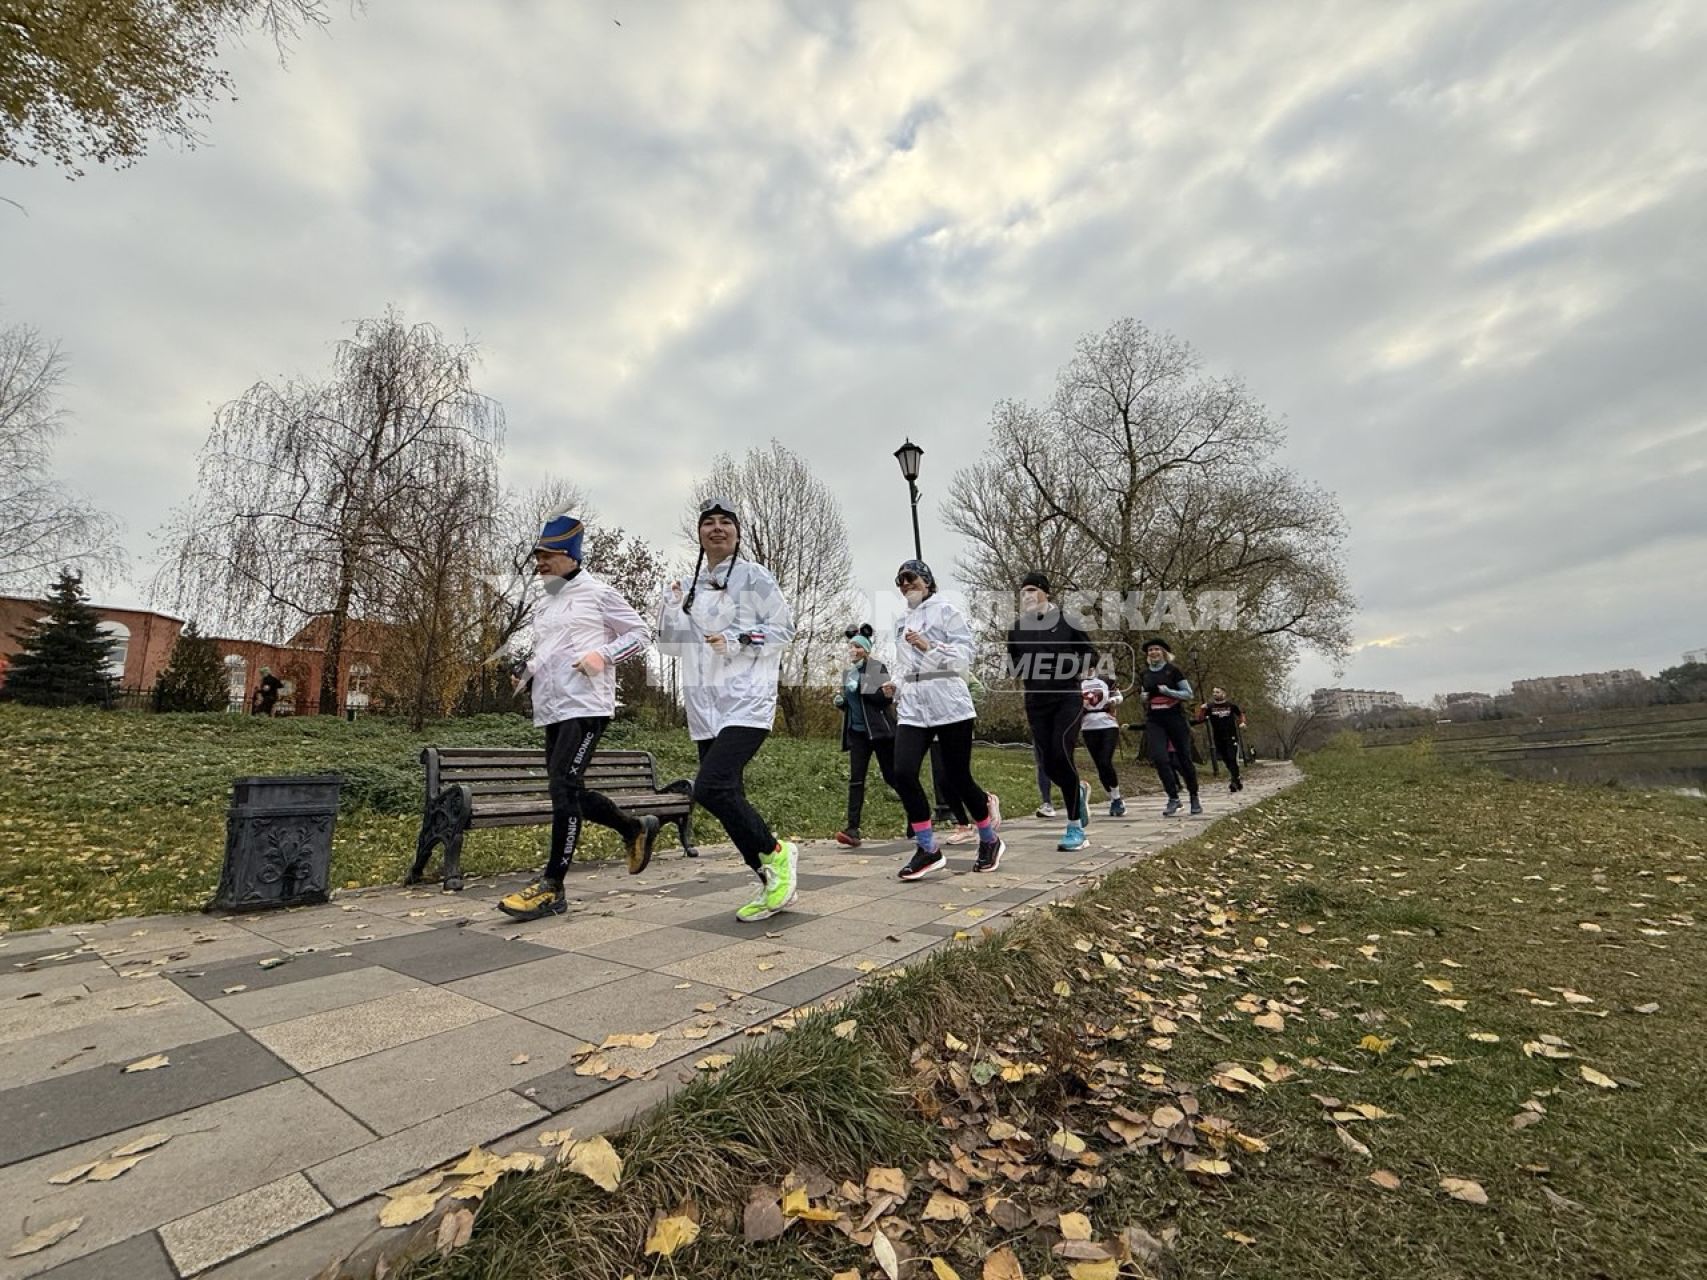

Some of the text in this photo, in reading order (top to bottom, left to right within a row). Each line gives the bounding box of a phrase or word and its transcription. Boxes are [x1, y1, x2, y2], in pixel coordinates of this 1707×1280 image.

[569, 732, 594, 775] X BIONIC
[560, 816, 577, 865] X BIONIC
